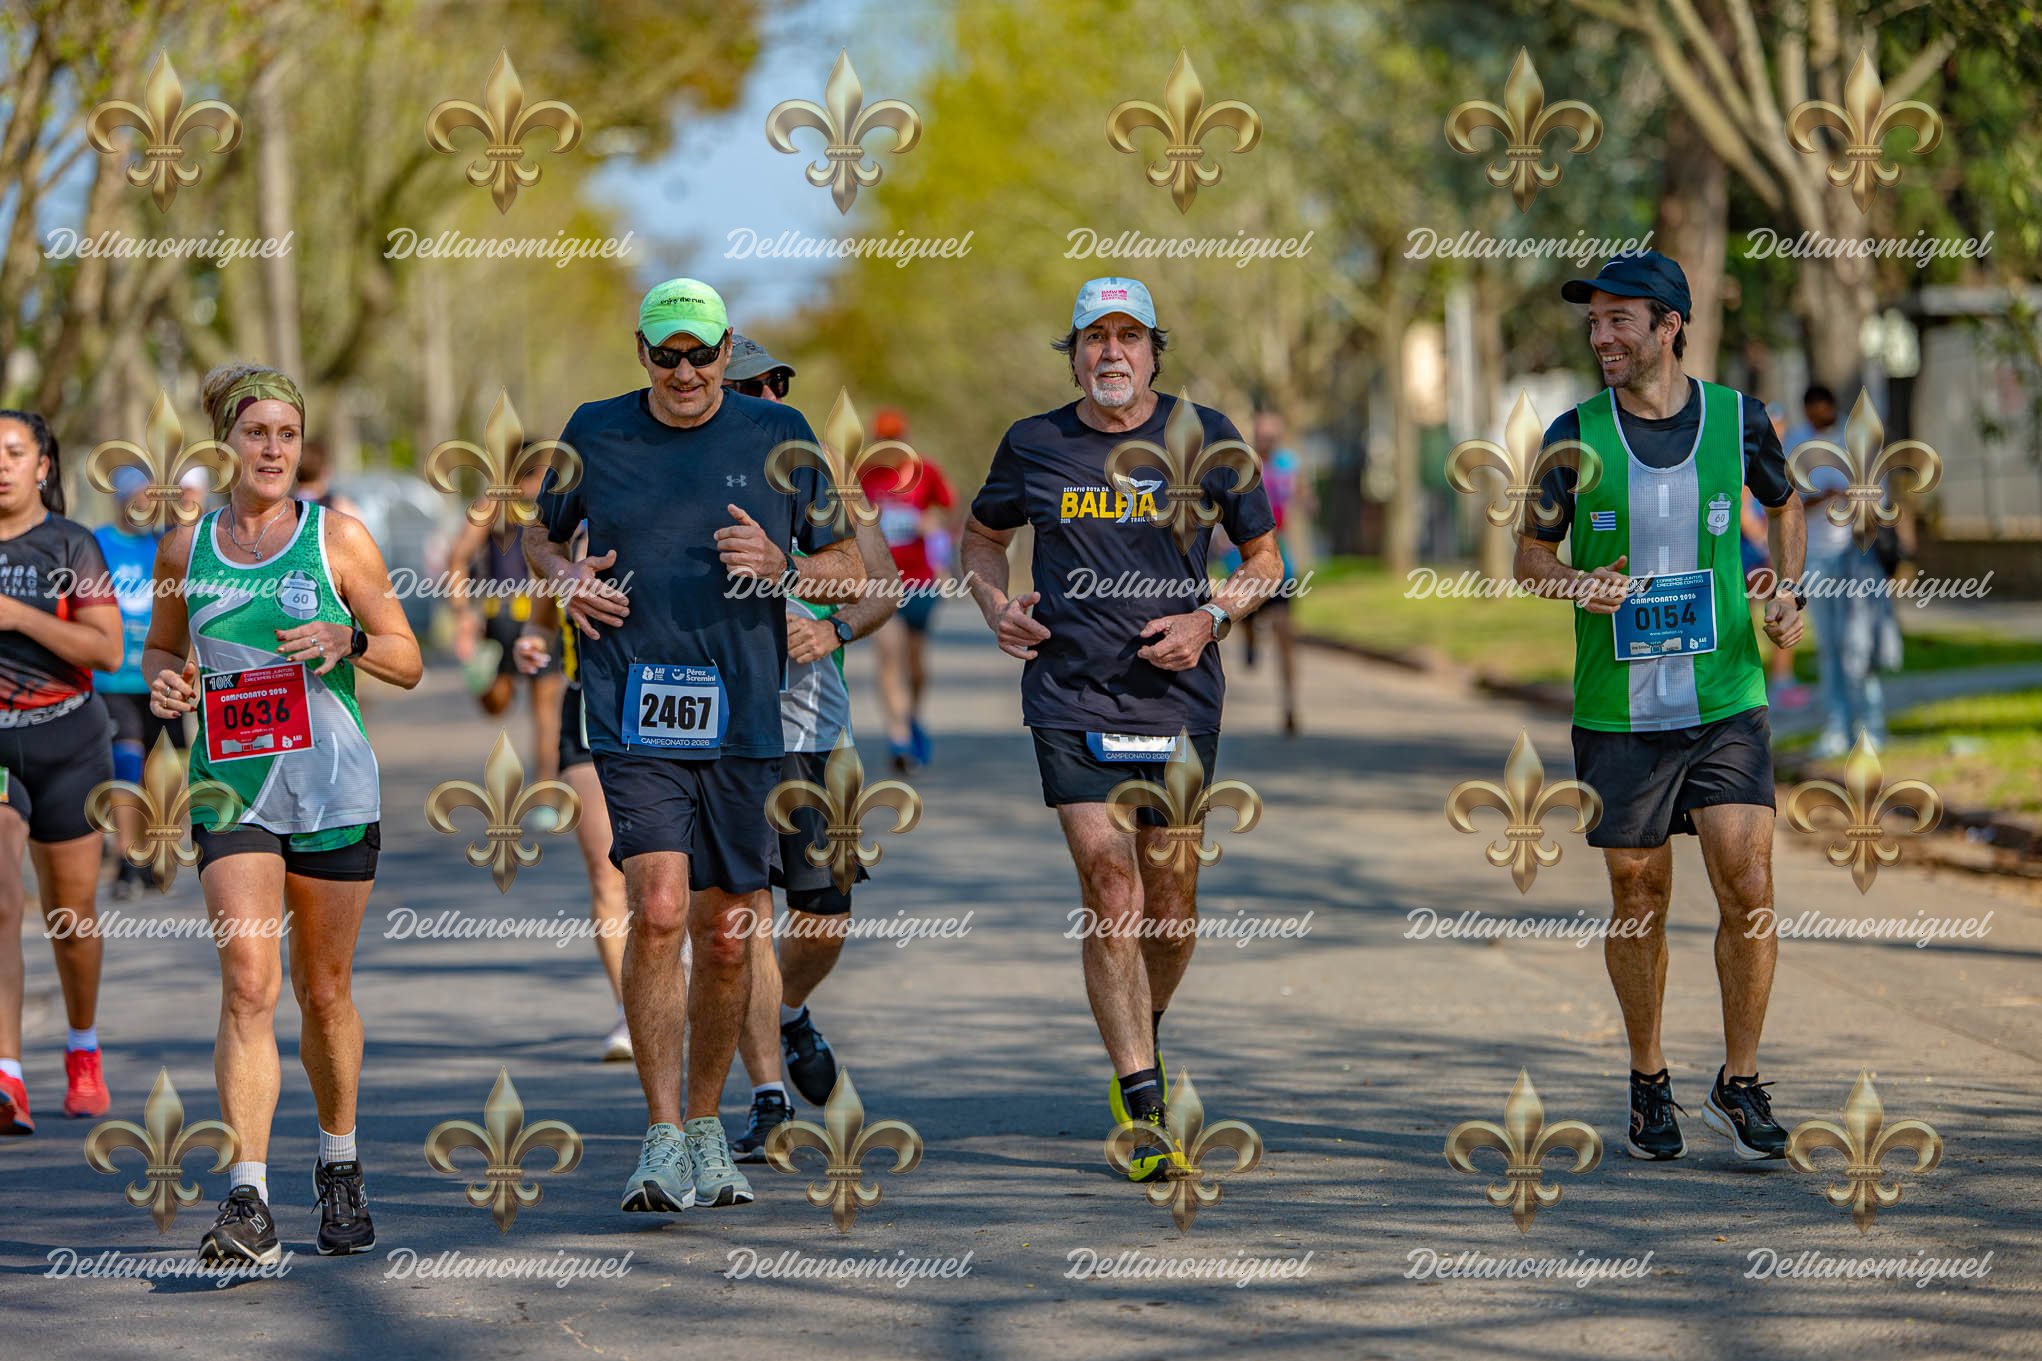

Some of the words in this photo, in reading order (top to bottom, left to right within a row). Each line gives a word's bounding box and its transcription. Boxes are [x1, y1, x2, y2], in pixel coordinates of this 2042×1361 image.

[292, 593, 309, 604] 60
[1630, 596, 1678, 604] CAMPEONATO
[1635, 602, 1696, 631] 0154
[686, 668, 706, 676] Pérez
[686, 674, 716, 682] Scremini
[209, 674, 234, 690] 10K
[220, 689, 267, 703] CAMPEONATO
[223, 697, 290, 730] 0636
[641, 693, 712, 730] 2467
[641, 737, 690, 746] CAMPEONATO
